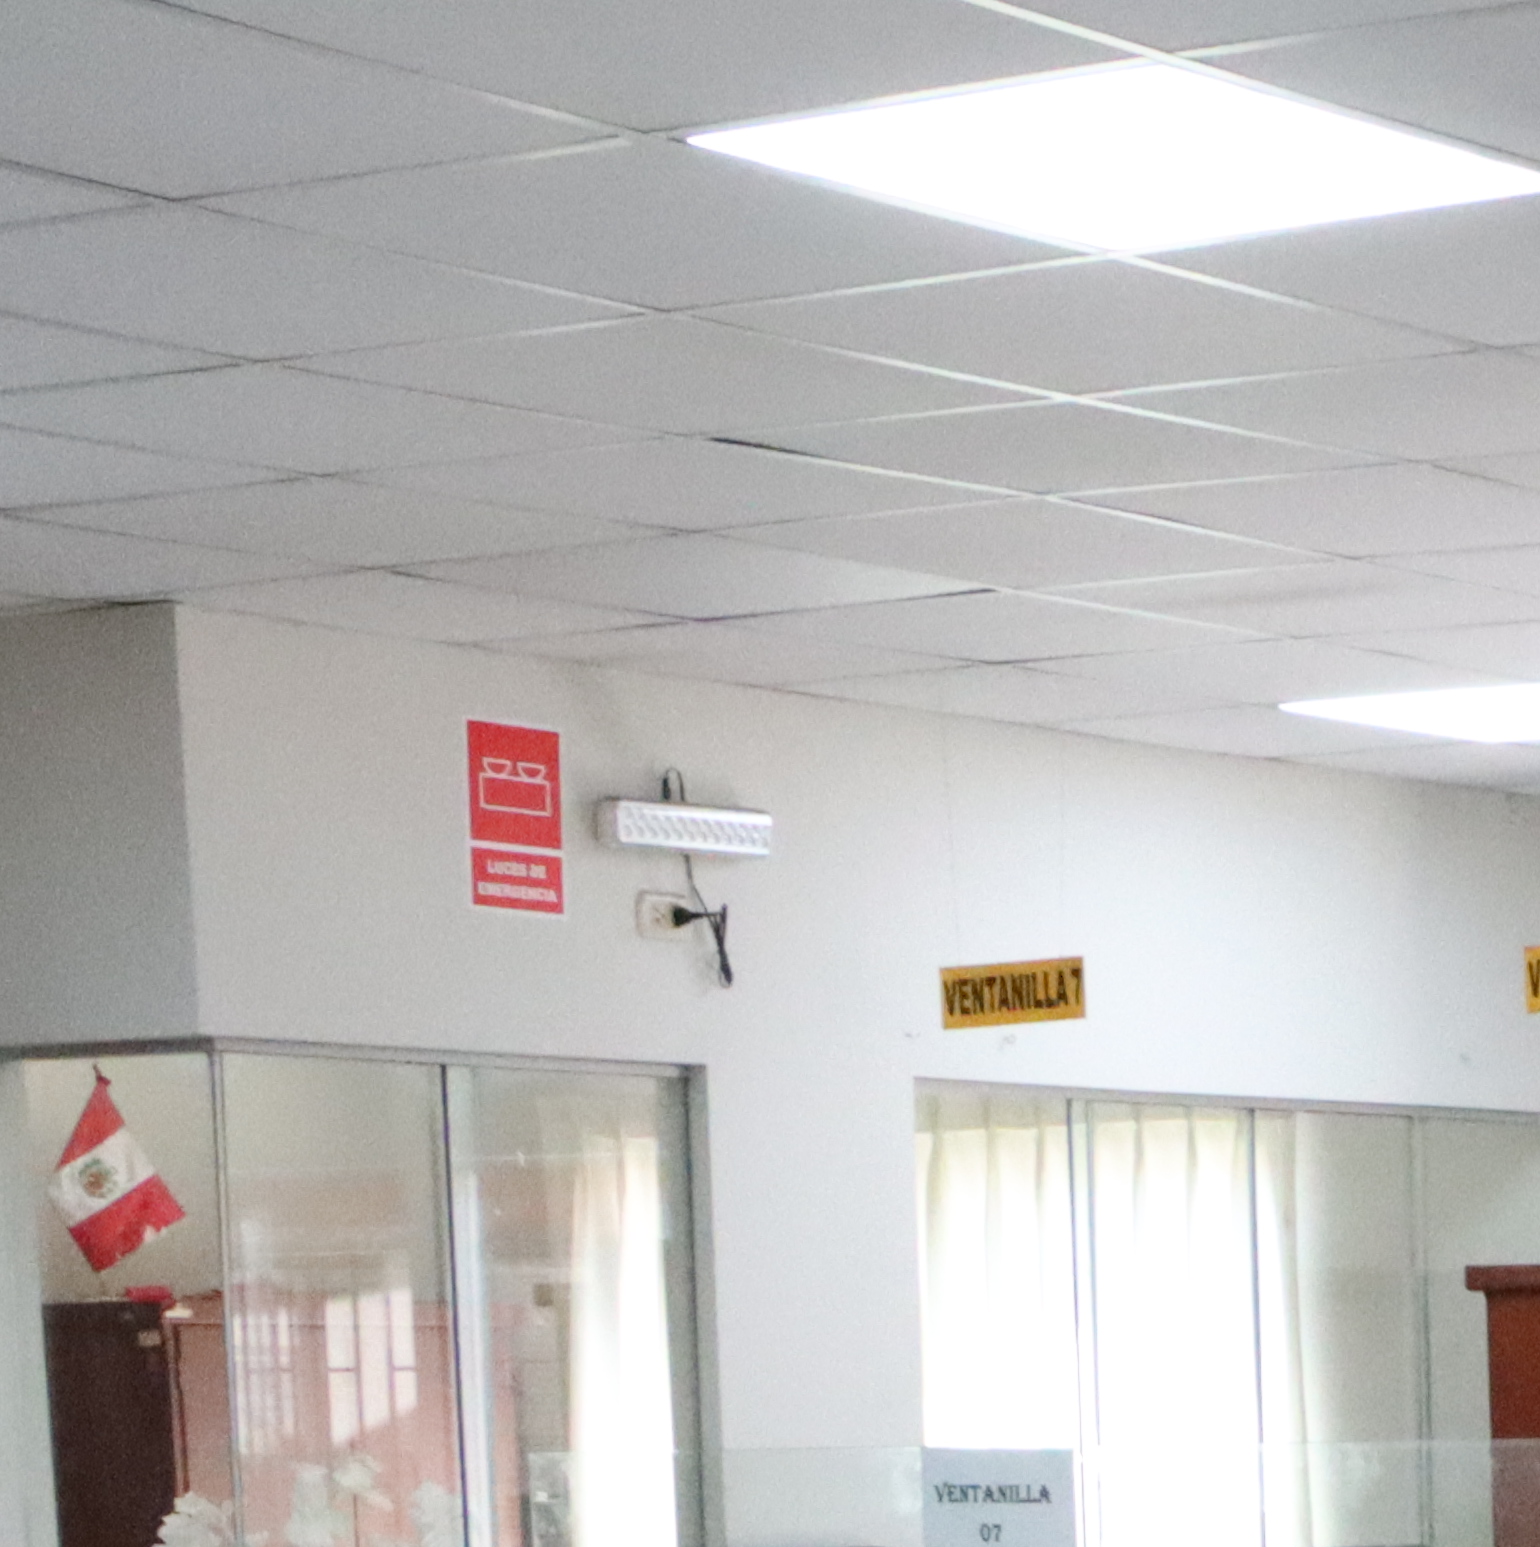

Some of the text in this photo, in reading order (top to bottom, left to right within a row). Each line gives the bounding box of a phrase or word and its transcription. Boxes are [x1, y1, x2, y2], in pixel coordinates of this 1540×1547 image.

[943, 967, 1082, 1016] VENTANILLA 7
[934, 1482, 1052, 1504] VENTANILLA
[979, 1523, 1002, 1542] 07
